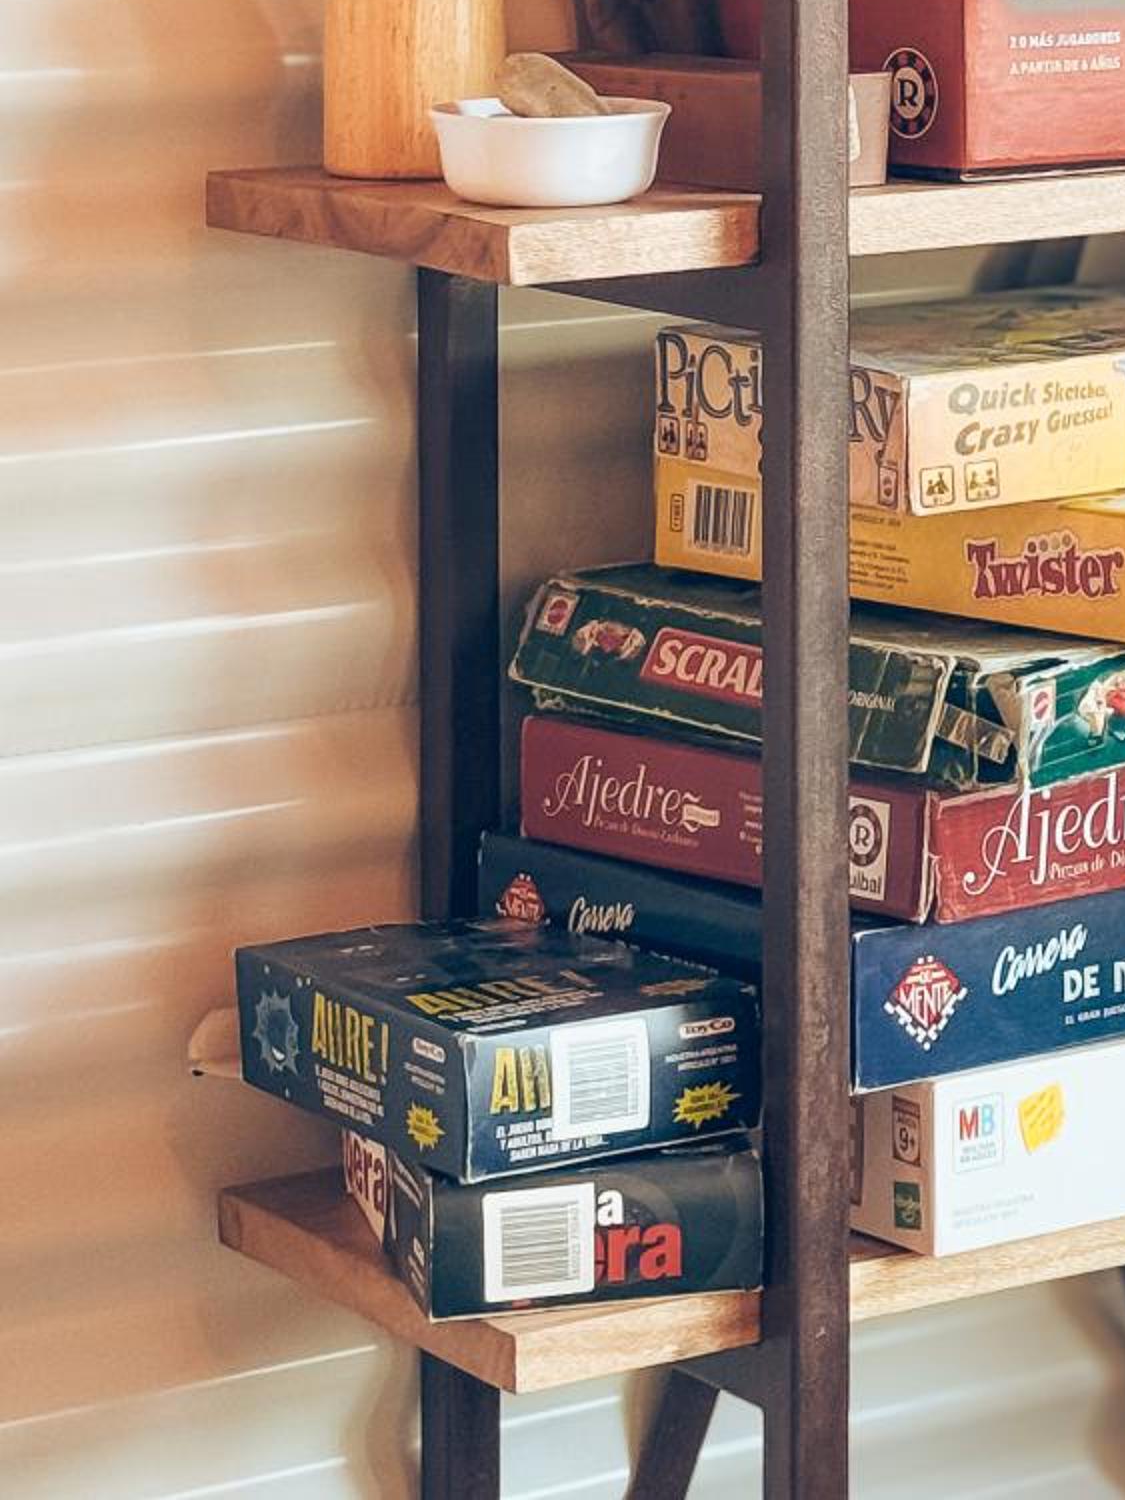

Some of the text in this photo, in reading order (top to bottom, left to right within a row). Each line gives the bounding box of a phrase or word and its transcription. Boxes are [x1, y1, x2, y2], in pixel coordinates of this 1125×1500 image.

[948, 382, 1037, 415] Quick
[954, 419, 1040, 456] Crazy
[967, 542, 1125, 600] Twister
[652, 638, 762, 697] SCRA
[1063, 966, 1100, 1004] DE
[959, 1103, 996, 1141] MB
